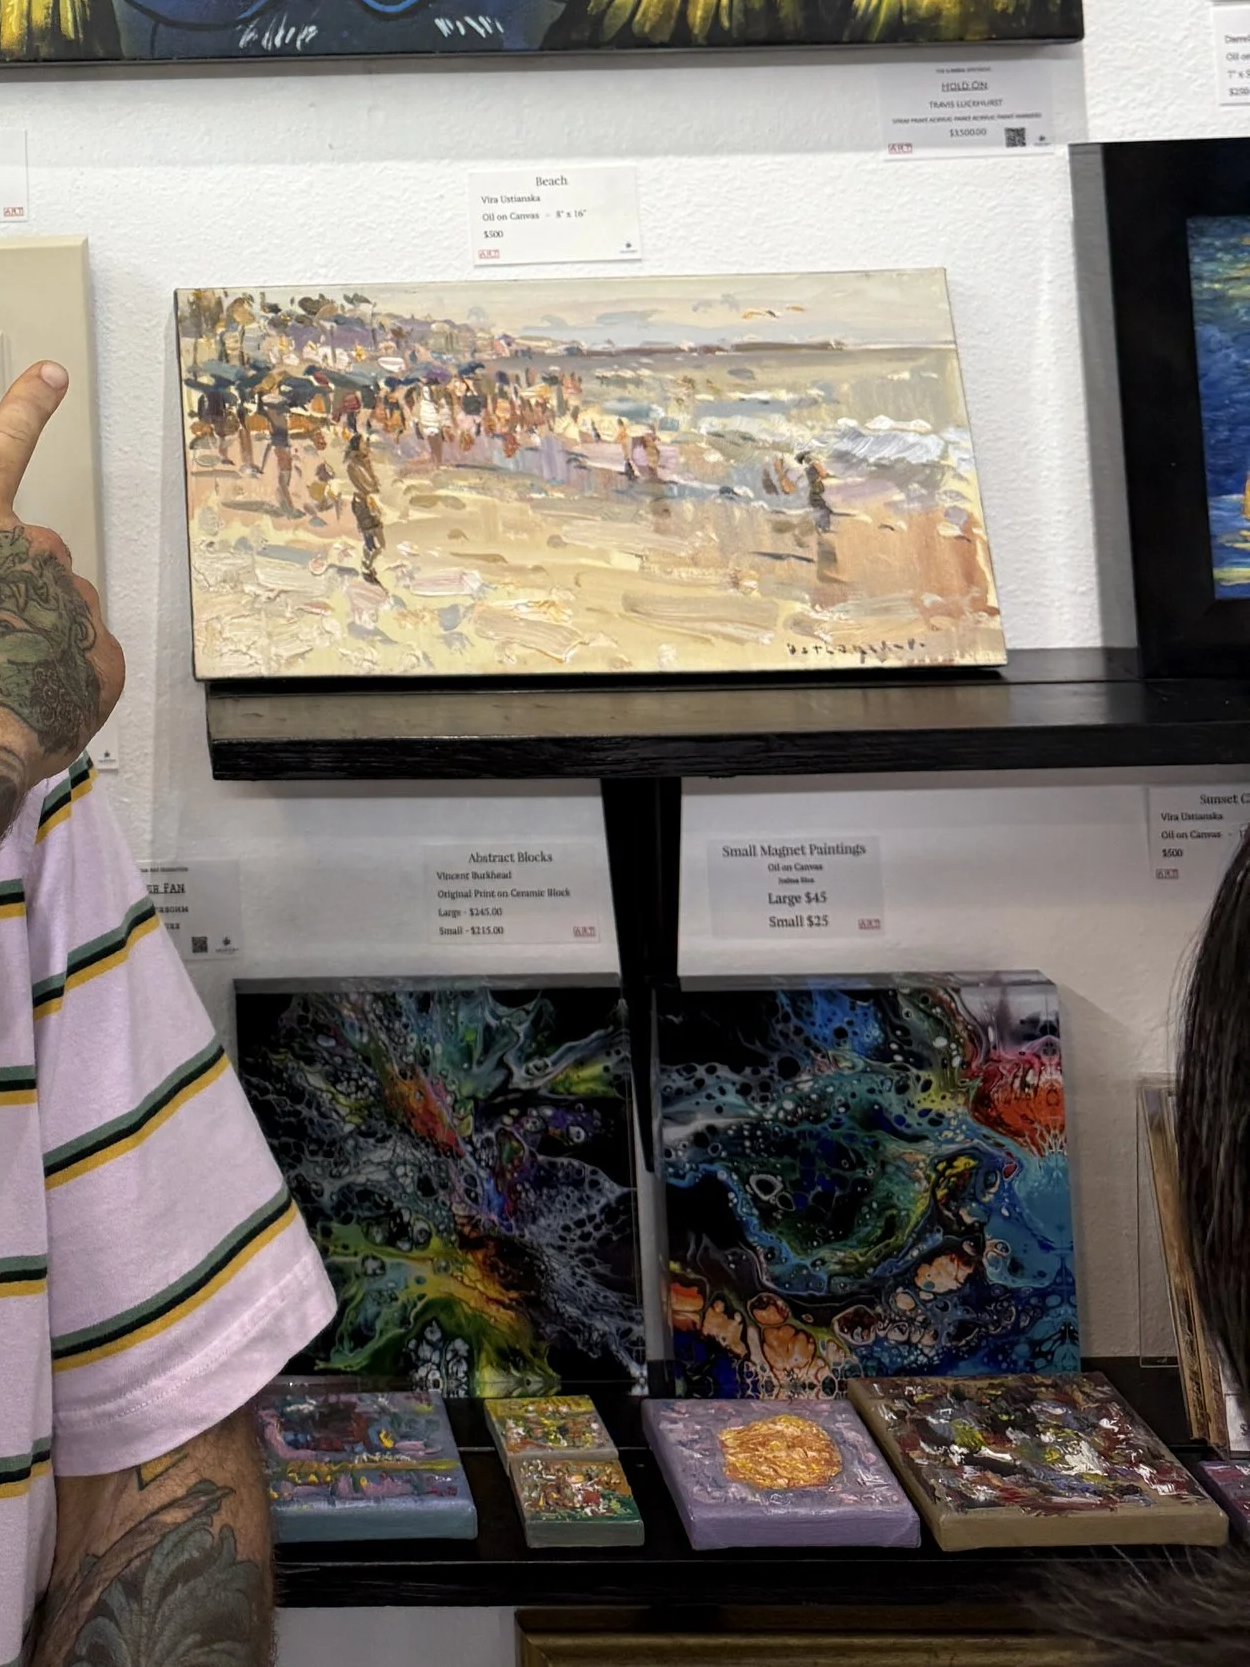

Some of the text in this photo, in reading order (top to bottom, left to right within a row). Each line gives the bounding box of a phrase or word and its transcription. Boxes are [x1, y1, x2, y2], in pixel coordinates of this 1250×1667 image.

[941, 81, 988, 92] HOLD ON
[929, 99, 1003, 109] TRAVIS LUCKHURST
[536, 175, 568, 187] Beach
[481, 194, 541, 204] Vira Ustianska
[3, 207, 24, 217] ART
[482, 213, 495, 222] Oil
[509, 212, 539, 220] Canvas
[574, 209, 587, 218] 16"
[483, 230, 504, 239] $500
[1200, 792, 1250, 805] Sunset C
[1161, 811, 1223, 821] Vira Ustianska
[1161, 830, 1175, 840] Oil
[1176, 832, 1188, 840] on
[1190, 830, 1222, 839] Canvas
[722, 842, 866, 859] Small Magnet Paintings
[468, 850, 553, 864] Abstract Blocks
[767, 863, 824, 872] Oil on Canvas
[436, 870, 512, 881] Vincent Burkhead
[163, 883, 186, 894] FAN
[437, 889, 472, 900] Original
[474, 889, 495, 898] Print
[510, 888, 545, 897] Ceramic
[547, 887, 571, 897] Block
[768, 891, 827, 907] Large $45
[438, 908, 461, 918] Large
[469, 907, 503, 917] $245.00
[769, 914, 829, 928] Small $25
[439, 926, 463, 936] Small
[471, 926, 504, 936] $215.00
